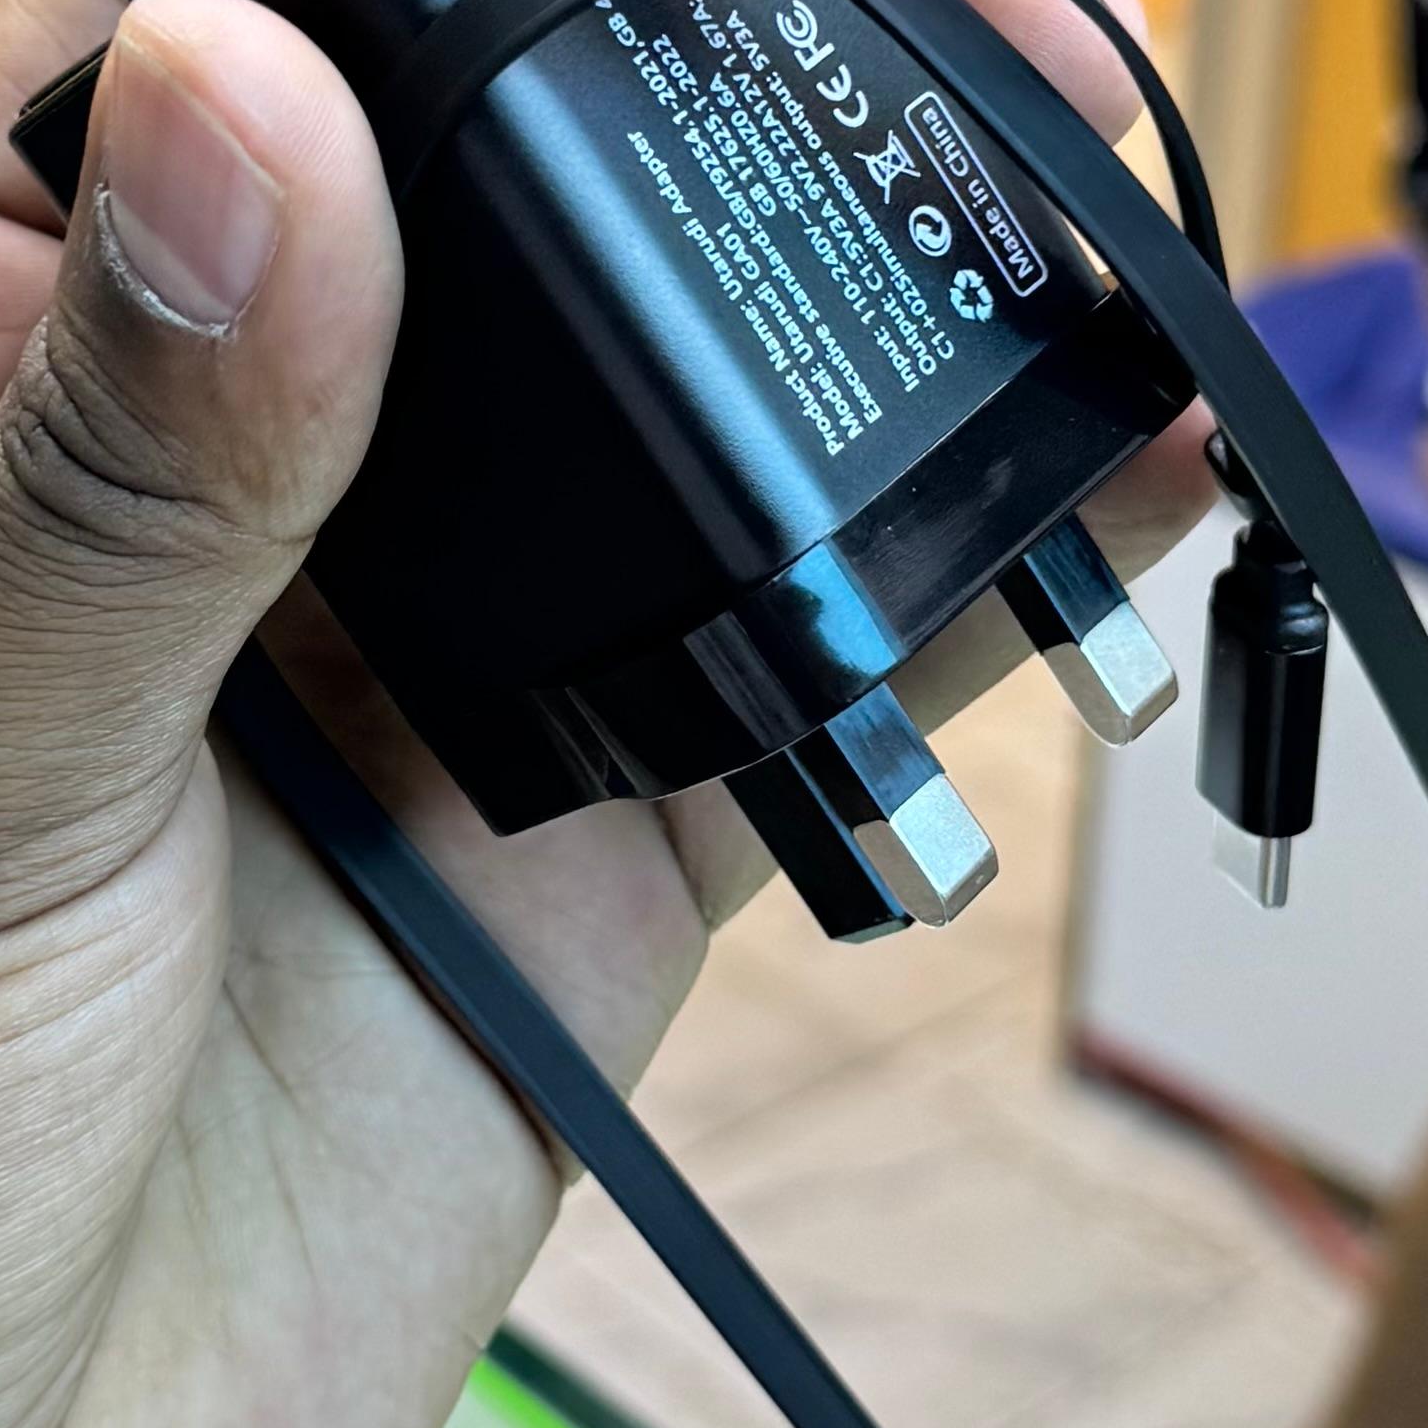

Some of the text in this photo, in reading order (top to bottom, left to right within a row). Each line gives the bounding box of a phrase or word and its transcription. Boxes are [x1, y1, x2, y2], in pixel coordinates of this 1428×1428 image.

[725, 8, 771, 72] 5V3A
[651, 32, 777, 217] GB 17625.1-2022
[764, 70, 822, 150] output:
[814, 62, 869, 128] CE
[921, 105, 1034, 279] Made in China
[819, 196, 884, 292] C1:5V3A
[626, 130, 845, 457] Product Name: Utarudi Adapter
[715, 221, 864, 440] Model: Utarudi GA01
[879, 291, 937, 376] Output:
[814, 322, 883, 424] Executive
[872, 324, 920, 393] Input:
